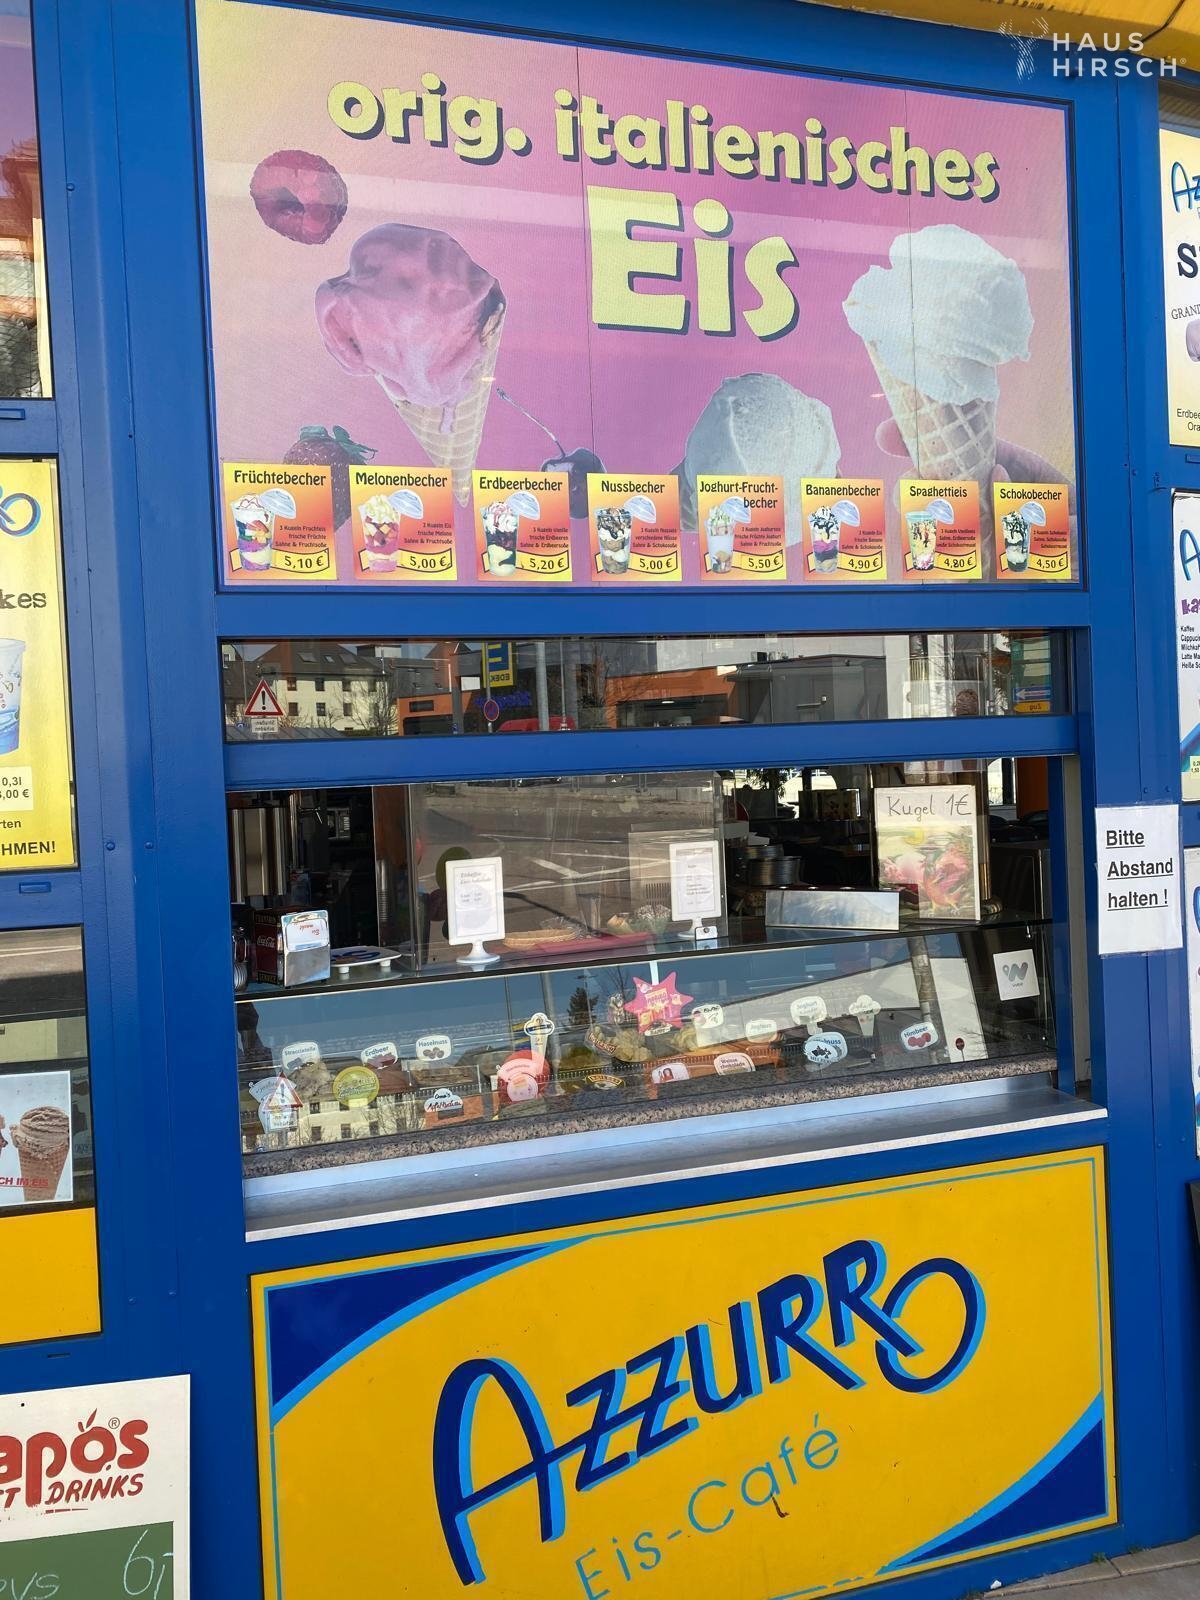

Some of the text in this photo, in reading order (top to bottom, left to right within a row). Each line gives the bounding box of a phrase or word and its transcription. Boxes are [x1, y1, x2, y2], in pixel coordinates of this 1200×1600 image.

[328, 72, 1000, 202] orig. italienisches
[587, 185, 799, 342] Eis
[234, 470, 326, 486] Früchtebecher
[356, 472, 448, 488] Melonenbecher
[480, 476, 562, 491] Erdbeerbecher
[602, 480, 665, 494] Nussbecher
[700, 482, 778, 493] Joghurt-Frucht-
[806, 484, 880, 496] Bananenbecher
[910, 486, 968, 497] Spaghettieis
[1000, 488, 1062, 500] Schokobecher
[744, 498, 778, 508] becher
[284, 556, 324, 568] 5,10 €
[410, 556, 446, 569] 5,00 €
[530, 558, 564, 570] 5,20 €
[640, 558, 672, 570] 5,00 €
[748, 556, 780, 570] 5,50 €
[848, 557, 878, 570] 4,90 €
[944, 556, 972, 568] 4,80 €
[1036, 558, 1064, 569] 4,50 €
[2, 776, 22, 788] 0,3l
[22, 788, 30, 798] €
[887, 794, 935, 822] Kugel
[1106, 829, 1145, 846] Bitte
[1, 841, 56, 856] HMEN!
[1107, 857, 1174, 877] Abstand
[1108, 891, 1158, 909] halten
[904, 1026, 928, 1038] Himbeer
[365, 1046, 389, 1056] Erdbeer
[16, 1178, 28, 1186] IM
[32, 1178, 48, 1186] EIS
[433, 1239, 985, 1586] AZZURRO
[45, 1473, 144, 1505] DRINKS
[574, 1413, 842, 1600] Eis-Café
